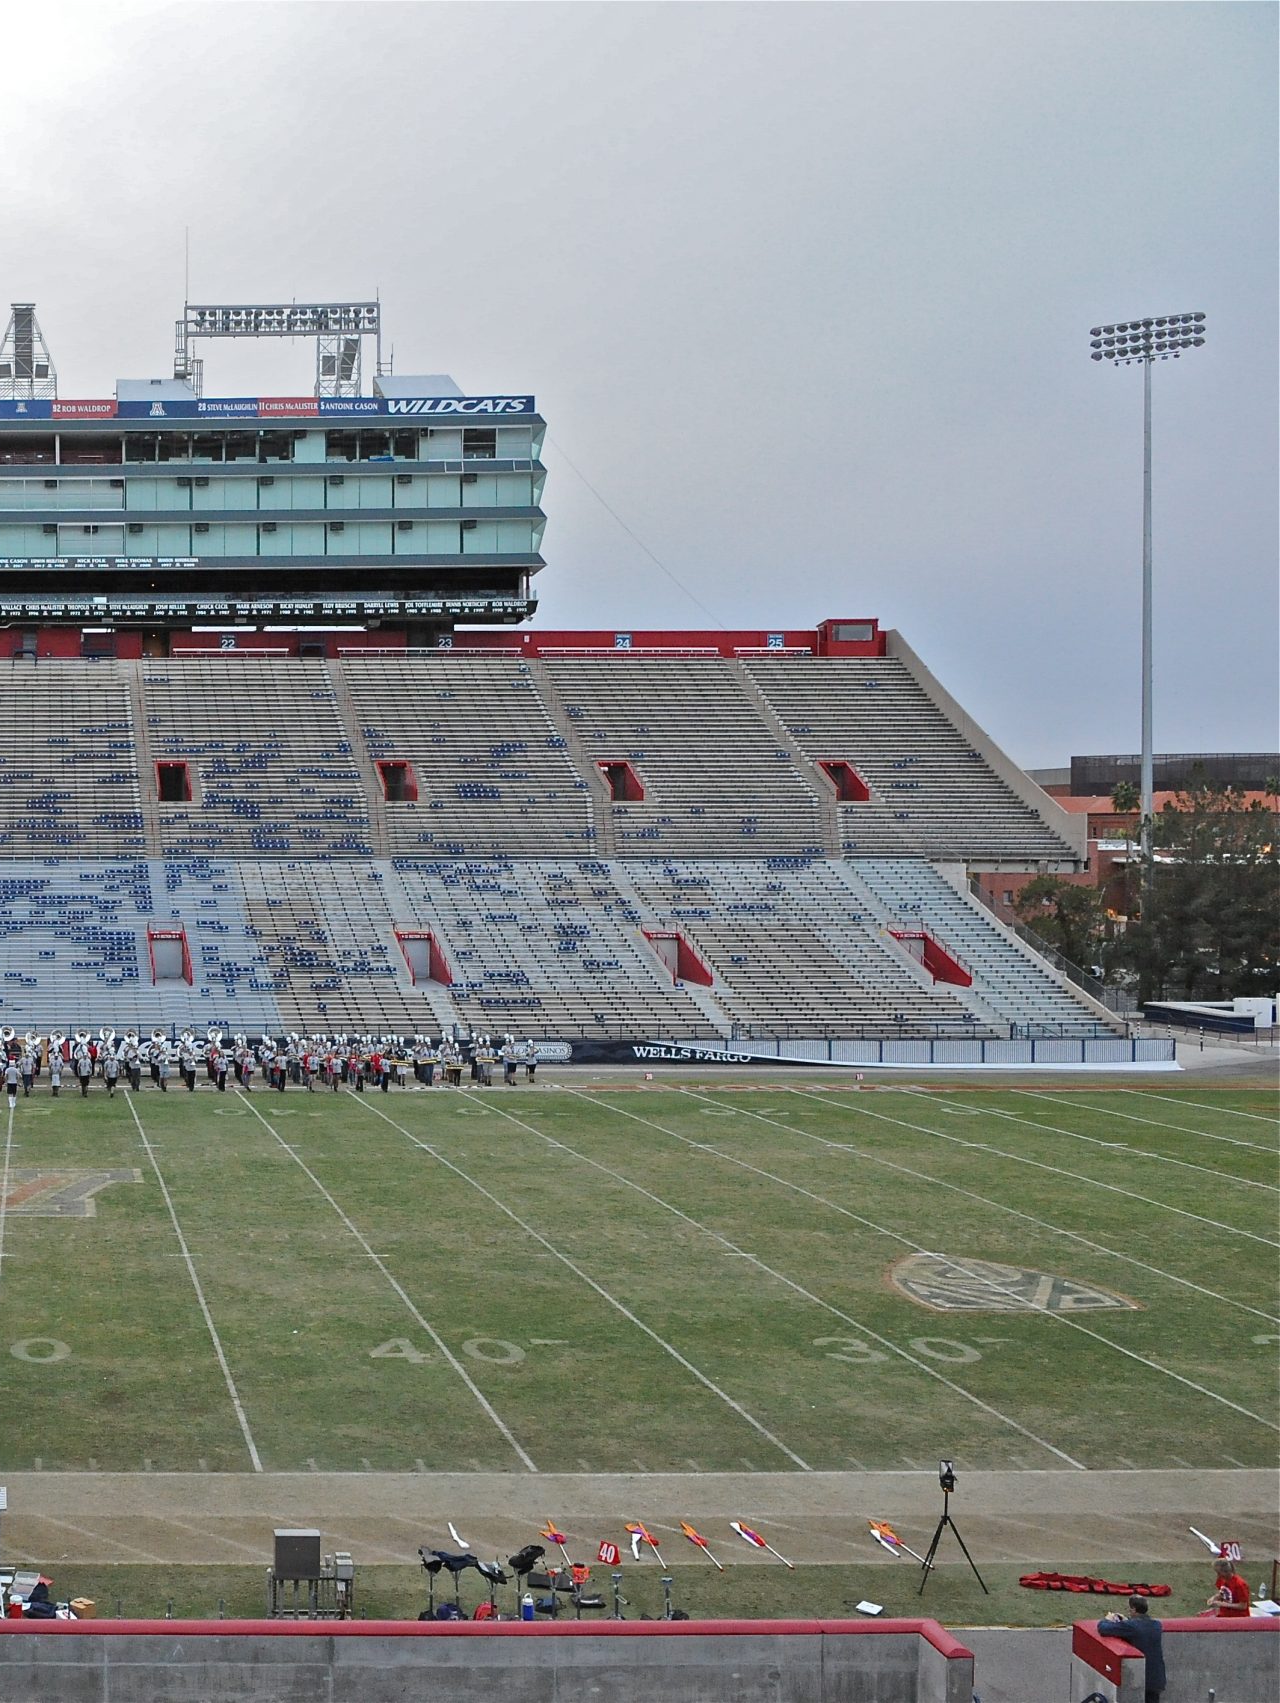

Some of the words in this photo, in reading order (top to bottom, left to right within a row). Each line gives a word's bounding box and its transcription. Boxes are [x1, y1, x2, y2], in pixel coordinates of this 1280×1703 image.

[52, 404, 61, 412] 92
[207, 403, 222, 411] STEVE
[223, 403, 257, 411] McLAUGHLIN
[259, 402, 265, 410] 11
[320, 402, 325, 410] 5
[387, 399, 527, 414] WILDCATS
[221, 639, 235, 648] 22
[438, 638, 452, 648] 23
[616, 638, 630, 648] 24
[769, 638, 783, 648] 25
[537, 1047, 566, 1055] ASINOS
[632, 1046, 691, 1059] WELLS
[369, 1337, 526, 1364] 40
[812, 1336, 982, 1363] 30
[599, 1543, 615, 1563] 40
[1223, 1543, 1241, 1561] 30
